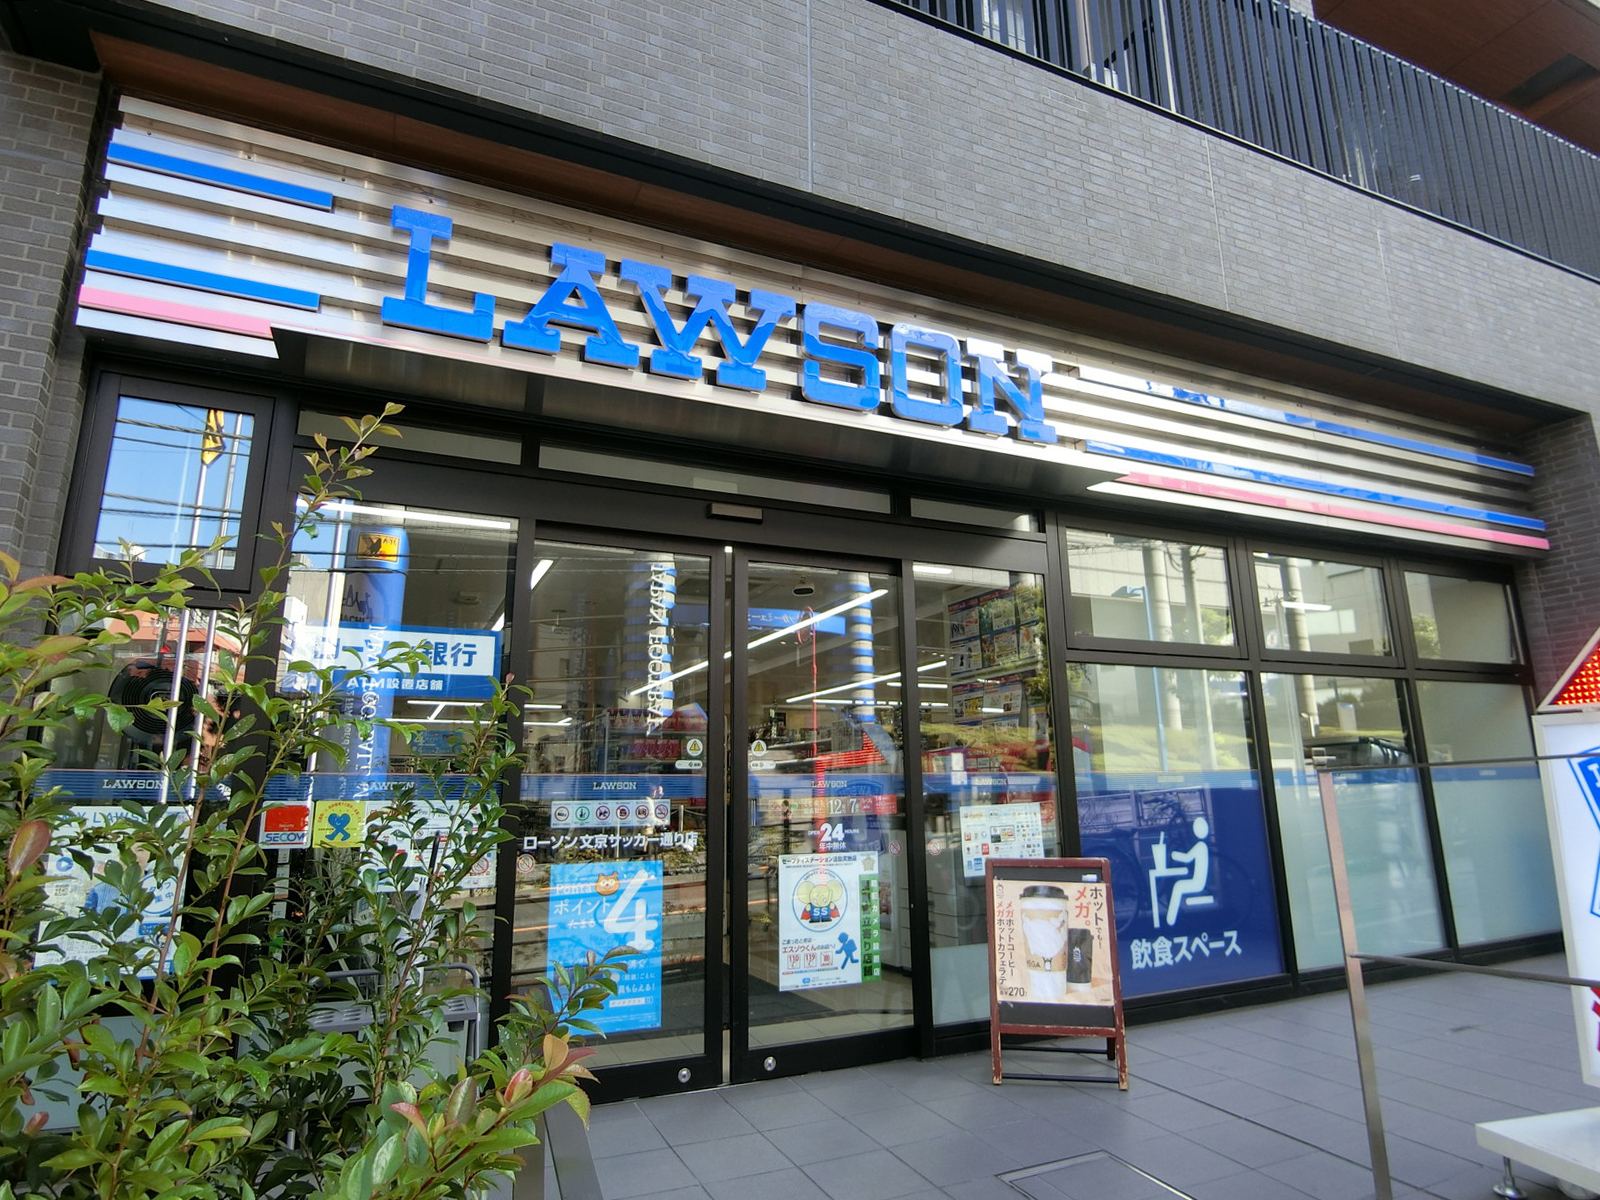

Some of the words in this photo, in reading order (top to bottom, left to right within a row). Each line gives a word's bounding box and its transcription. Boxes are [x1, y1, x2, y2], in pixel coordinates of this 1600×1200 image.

[381, 205, 1058, 447] LAWSON
[102, 779, 164, 789] LAWSON
[592, 781, 637, 791] LAWSON
[265, 832, 307, 843] SECOM
[523, 831, 699, 851] ローソン文京サッカー通り店
[820, 823, 845, 842] 24
[556, 882, 593, 895] Ponta
[553, 896, 611, 915] ポイント
[603, 869, 658, 951] 4
[996, 901, 1008, 985] メガホットカフェラテ
[1005, 901, 1016, 977] メガホットコーヒー
[1129, 930, 1242, 970] 飲食スペース
